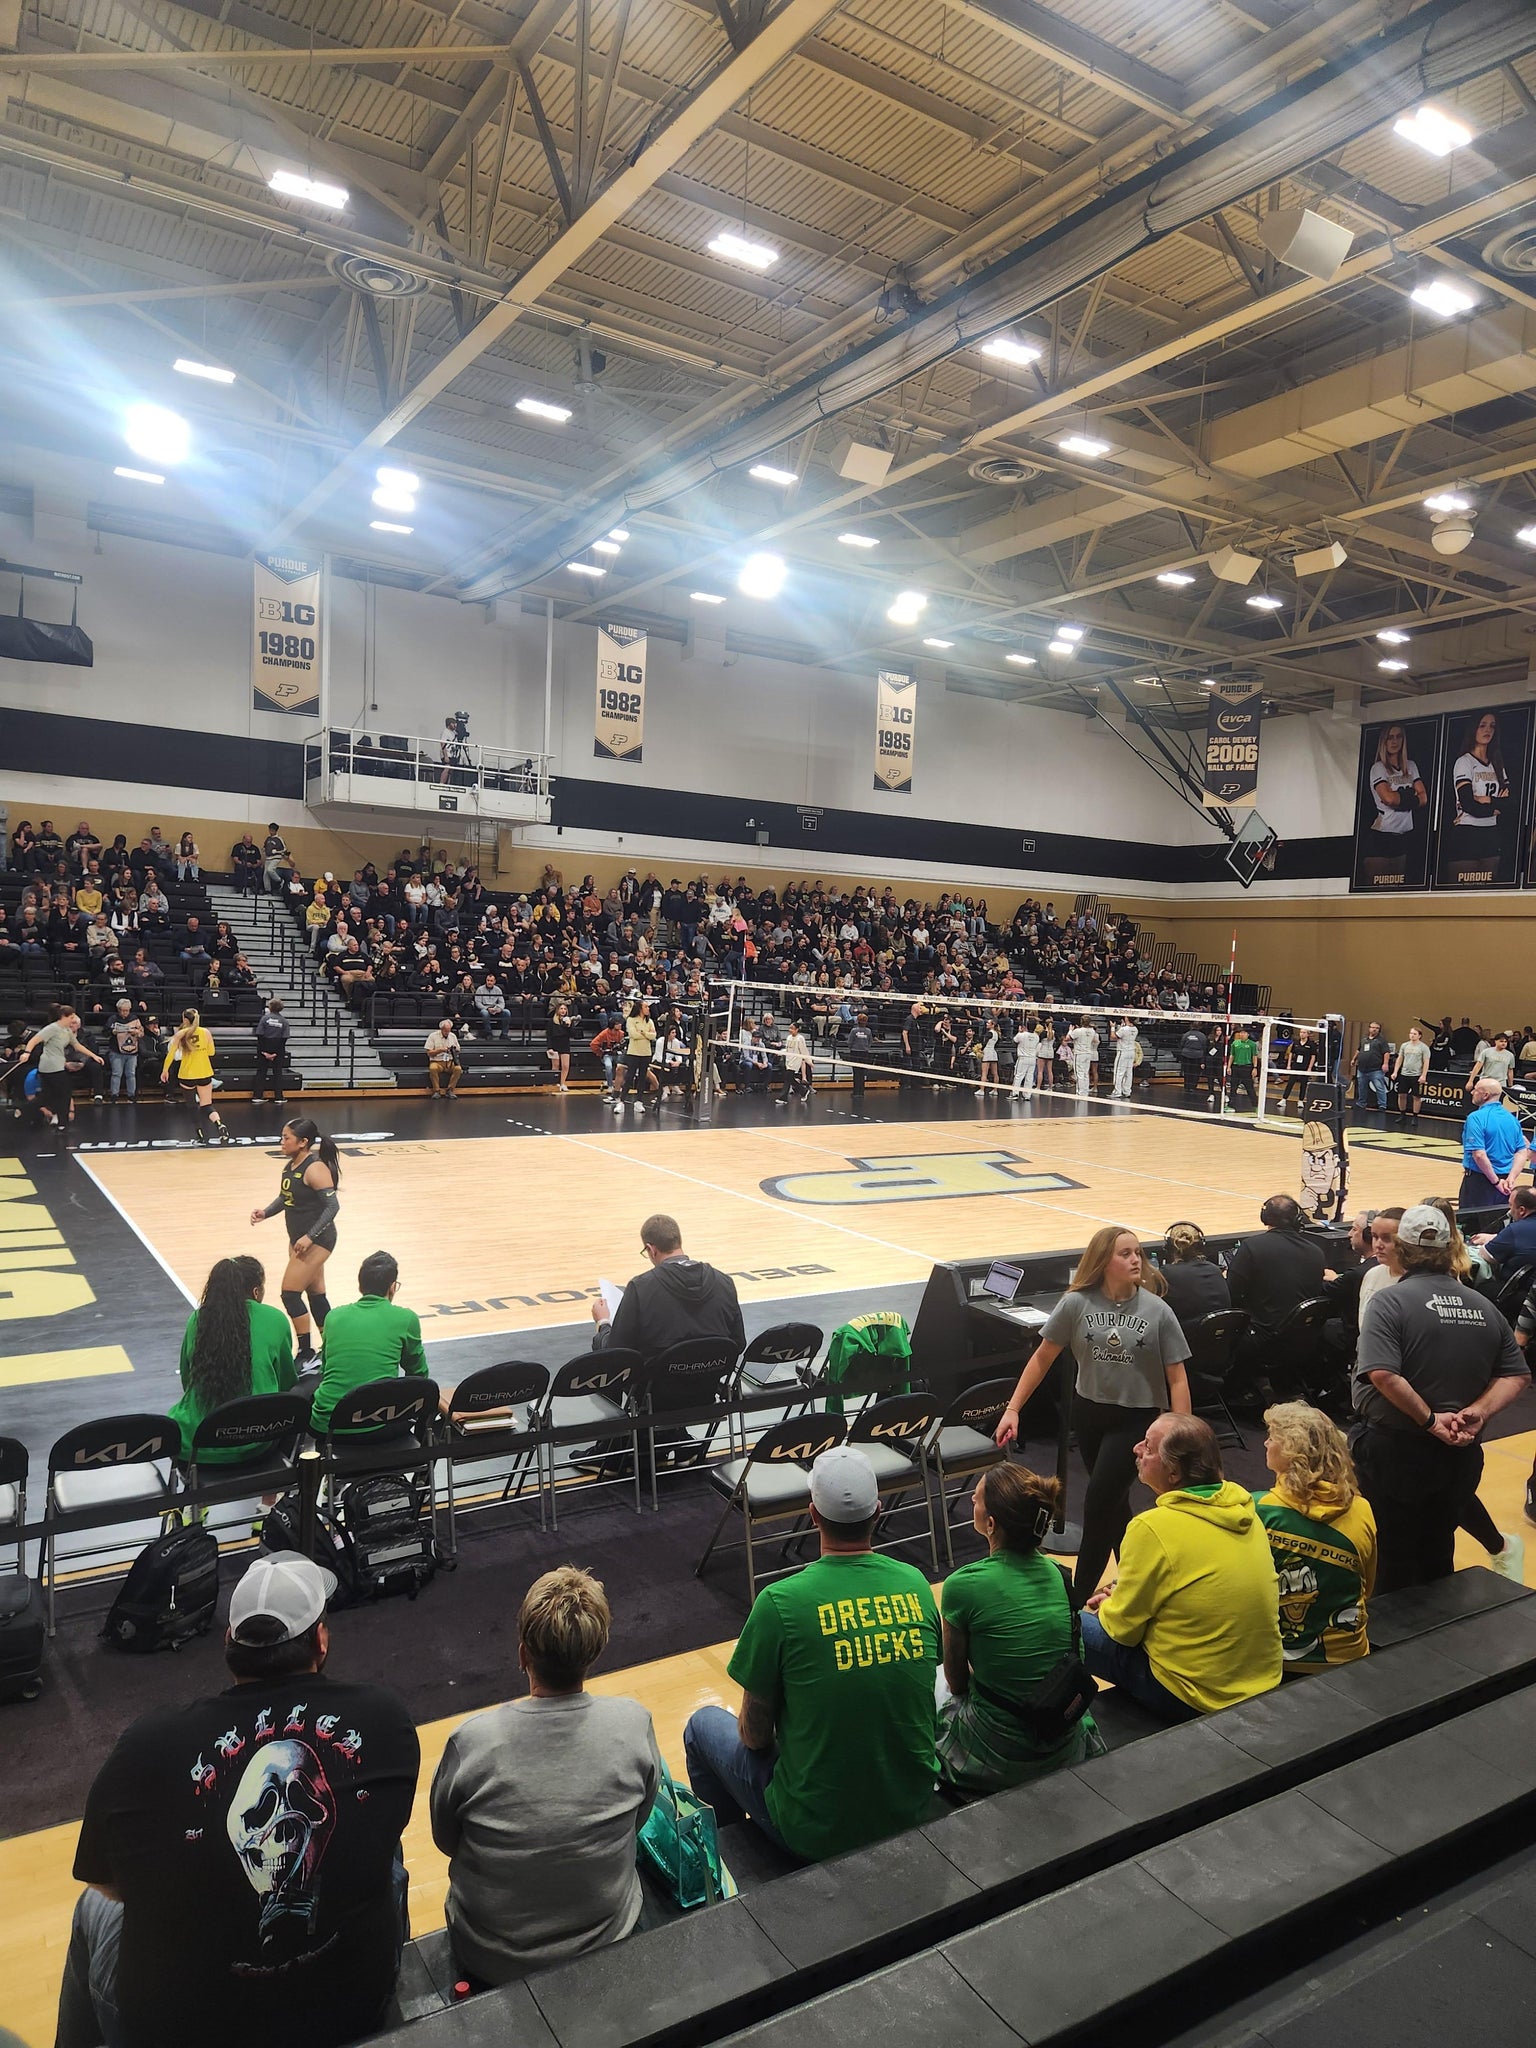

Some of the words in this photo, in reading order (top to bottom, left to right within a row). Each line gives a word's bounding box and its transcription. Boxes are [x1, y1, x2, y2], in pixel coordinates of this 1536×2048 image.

[268, 556, 307, 572] PURDUE
[608, 623, 638, 638] PURDUE
[259, 631, 314, 660] 1980
[262, 656, 311, 670] CHAMPIONS
[1220, 684, 1253, 693] PURDUE
[600, 689, 640, 714] 1982
[601, 710, 637, 722] CHAMPIONS
[1221, 714, 1252, 723] avca
[878, 730, 911, 751] 1985
[880, 748, 908, 758] CHAMPIONS
[1207, 744, 1258, 763] 2006
[1236, 763, 1256, 771] FAME
[1485, 783, 1497, 796] 12
[1373, 874, 1405, 884] PURDUE
[1457, 871, 1493, 882] PURDUE
[1419, 1082, 1463, 1099] ision
[1309, 1100, 1332, 1112] P
[758, 1151, 1090, 1206] P
[725, 1263, 837, 1282] BEL
[421, 1284, 626, 1318] OUR
[1432, 1294, 1463, 1306] ALLIED
[1437, 1305, 1484, 1320] UNIVERSAL
[1085, 1311, 1149, 1334] PURDUE
[668, 1356, 727, 1372] ROHRMAN
[469, 1384, 535, 1402] ROHRMAN
[215, 1416, 296, 1438] ROHRMAN
[1321, 1549, 1359, 1567] DUCKS
[817, 1593, 924, 1636] OREGON
[834, 1628, 924, 1671] DUCKS
